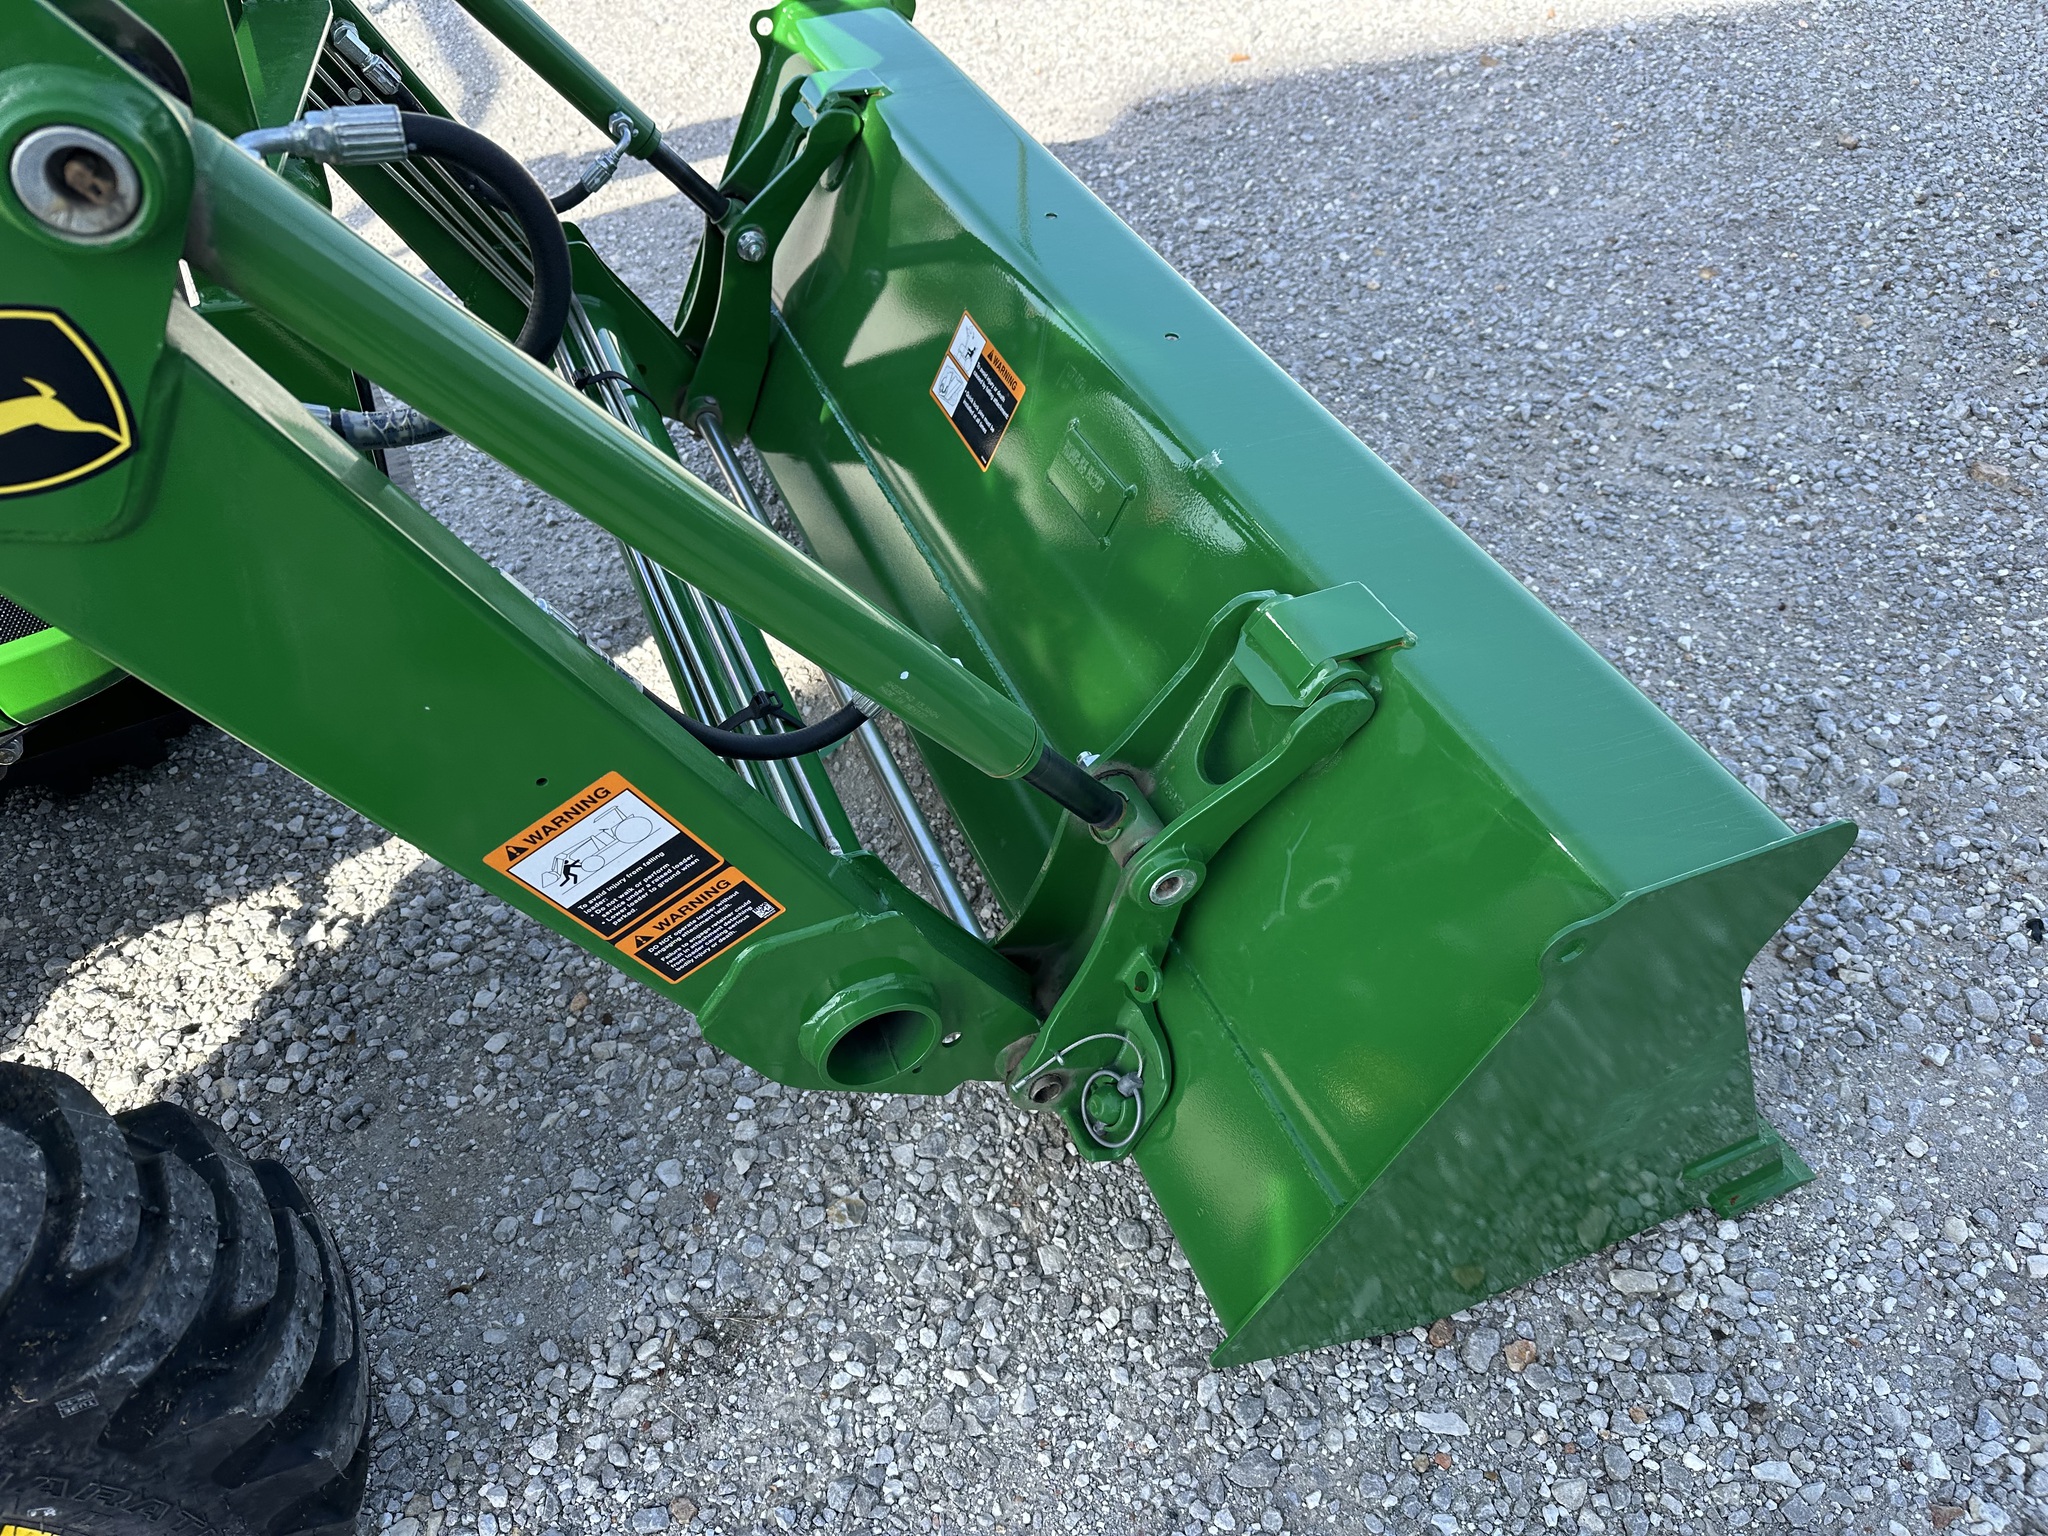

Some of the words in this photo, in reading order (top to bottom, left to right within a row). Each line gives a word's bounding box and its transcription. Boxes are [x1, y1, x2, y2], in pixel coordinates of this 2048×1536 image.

[979, 367, 989, 380] avoid
[986, 376, 995, 390] injury
[992, 355, 1018, 391] WARNING
[522, 786, 612, 845] WARNING
[587, 889, 608, 905] avoid
[605, 877, 627, 892] injury
[625, 866, 644, 879] from
[642, 851, 666, 867] falling
[594, 906, 606, 915] Do
[605, 897, 619, 908] not
[617, 887, 635, 899] walk
[642, 863, 671, 883] perform
[601, 900, 626, 918] service
[625, 886, 645, 902] under
[651, 868, 673, 885] raised
[671, 853, 696, 870] loader.
[605, 906, 627, 922] Lower
[626, 891, 649, 908] loader
[657, 869, 682, 888] ground
[680, 858, 700, 872] when
[583, 897, 609, 915] loader:
[612, 907, 638, 926] parked.
[647, 944, 660, 953] DO
[658, 934, 673, 946] NOT
[673, 919, 697, 937] operate
[695, 905, 716, 921] loader
[715, 890, 740, 907] without
[652, 879, 732, 932] WARNING
[653, 936, 683, 957] engaging
[681, 913, 716, 938] attachment
[713, 903, 733, 915] latch.
[660, 947, 682, 962] Failure
[688, 927, 712, 943] engage
[710, 911, 734, 929] retainer
[734, 899, 752, 913] could
[666, 952, 684, 966] result
[689, 925, 724, 950] attachment
[723, 905, 754, 927] detaching
[670, 957, 686, 969] from
[684, 944, 705, 959] loader
[704, 929, 729, 946] causing
[727, 914, 750, 931] serious
[674, 958, 695, 972] bodily
[693, 946, 711, 960] injury
[717, 930, 738, 944] death.
